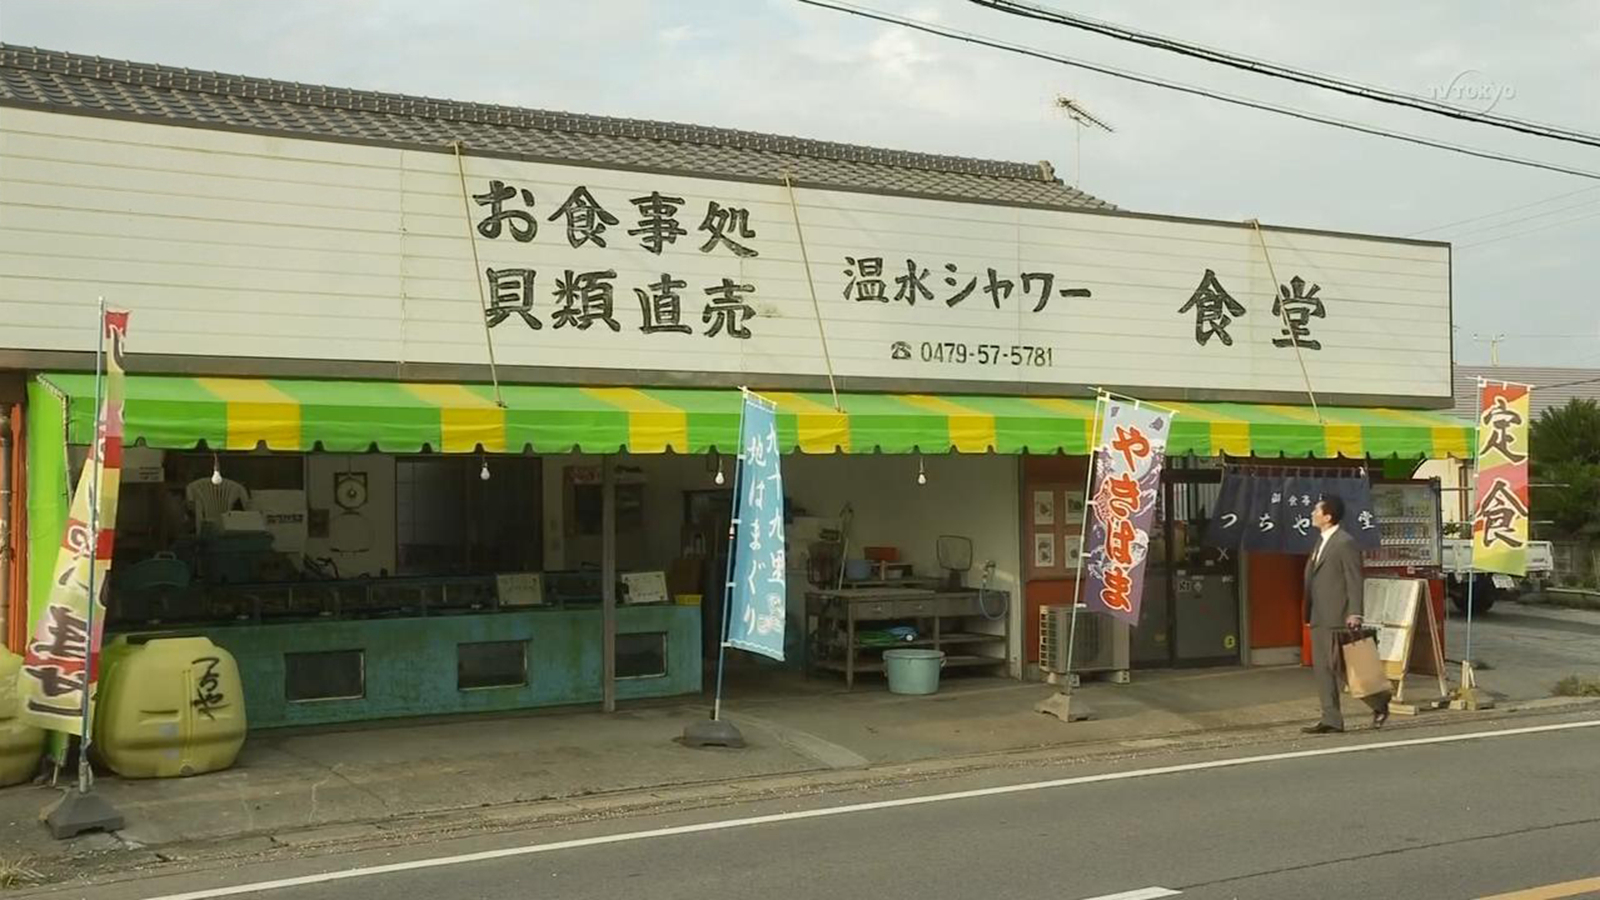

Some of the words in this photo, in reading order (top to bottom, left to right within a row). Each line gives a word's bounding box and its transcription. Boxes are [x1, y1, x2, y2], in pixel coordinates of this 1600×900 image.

[472, 180, 758, 257] お食事処
[485, 267, 757, 339] 貝類直売
[843, 256, 1092, 312] 温水シャワー
[1178, 268, 1326, 351] 食堂
[920, 344, 1054, 367] 0479-57-5781
[1475, 396, 1529, 549] 定食
[743, 436, 766, 636] 地はまぐり
[1220, 510, 1376, 537] つちや堂
[191, 657, 231, 720] つちや
